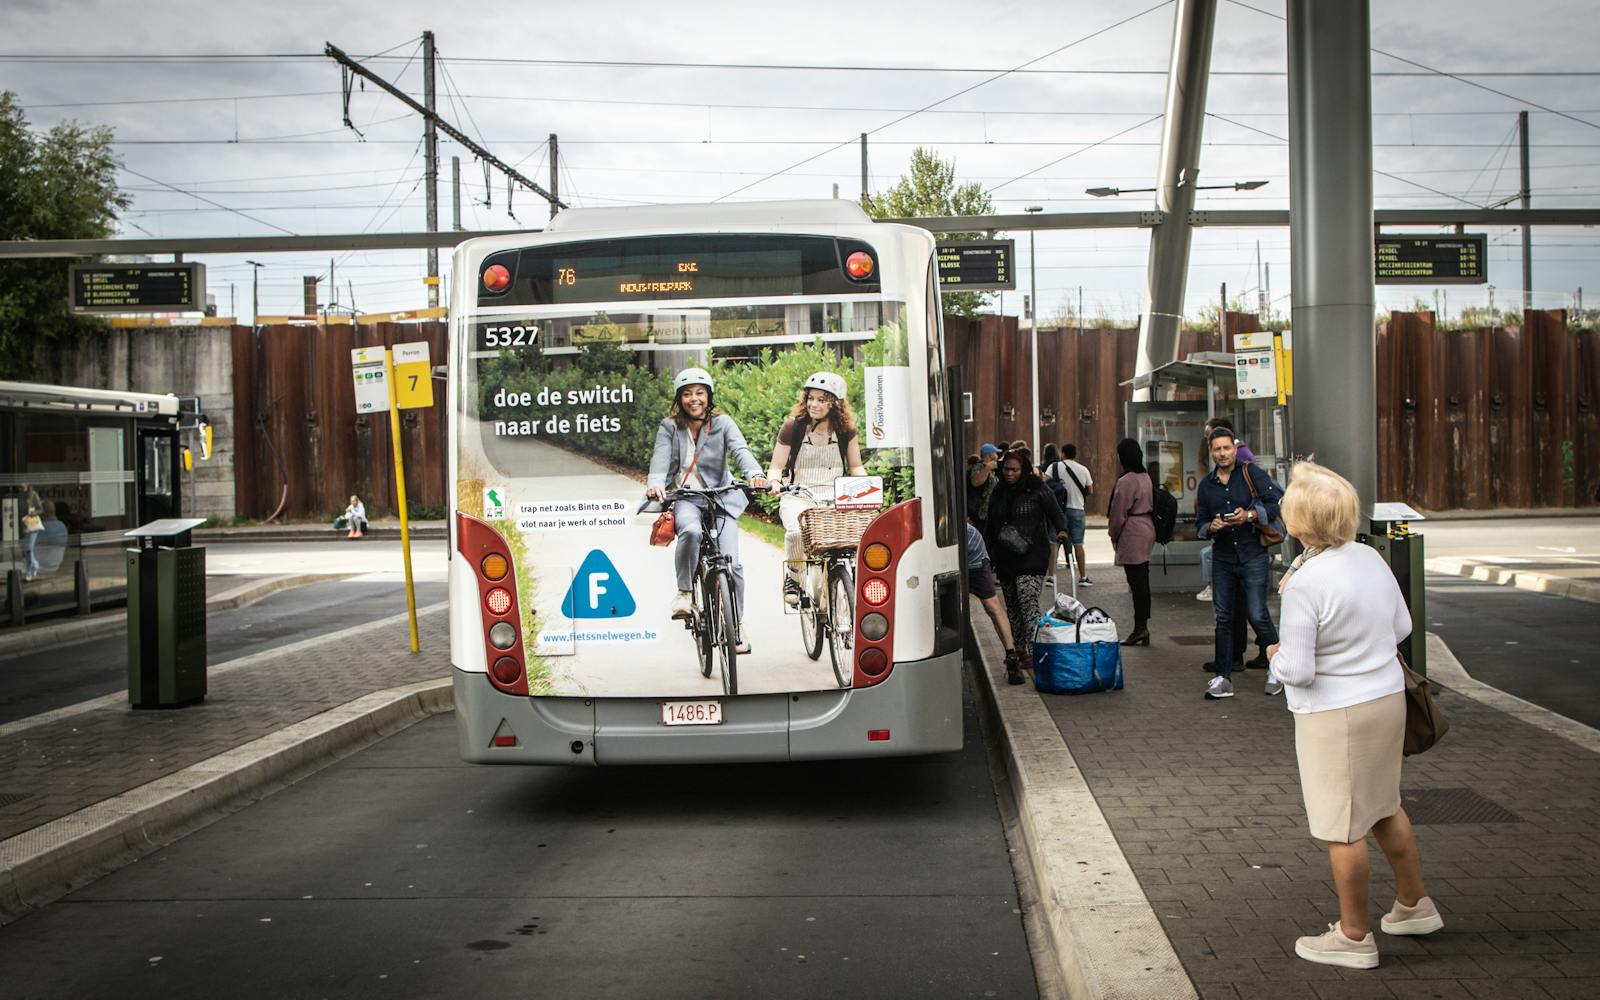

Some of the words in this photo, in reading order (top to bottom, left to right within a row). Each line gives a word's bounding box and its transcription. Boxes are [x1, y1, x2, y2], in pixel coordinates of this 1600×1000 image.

[678, 262, 698, 272] EKE
[558, 268, 576, 286] 76
[485, 326, 538, 347] 5327
[408, 375, 418, 391] 7
[494, 388, 531, 407] doe
[537, 386, 562, 406] de
[567, 383, 634, 405] switch
[495, 420, 540, 436] naar
[545, 415, 570, 434] de
[576, 414, 621, 433] fiets
[520, 505, 537, 514] trap
[555, 504, 576, 512] zoals
[578, 503, 600, 511] Binta
[521, 520, 537, 528] vlot
[558, 520, 566, 528] je
[589, 518, 597, 526] of
[599, 518, 626, 526] school
[589, 572, 609, 609] F
[543, 630, 657, 642] www.fietssnelwegen.be
[668, 704, 717, 722] 1486.P
